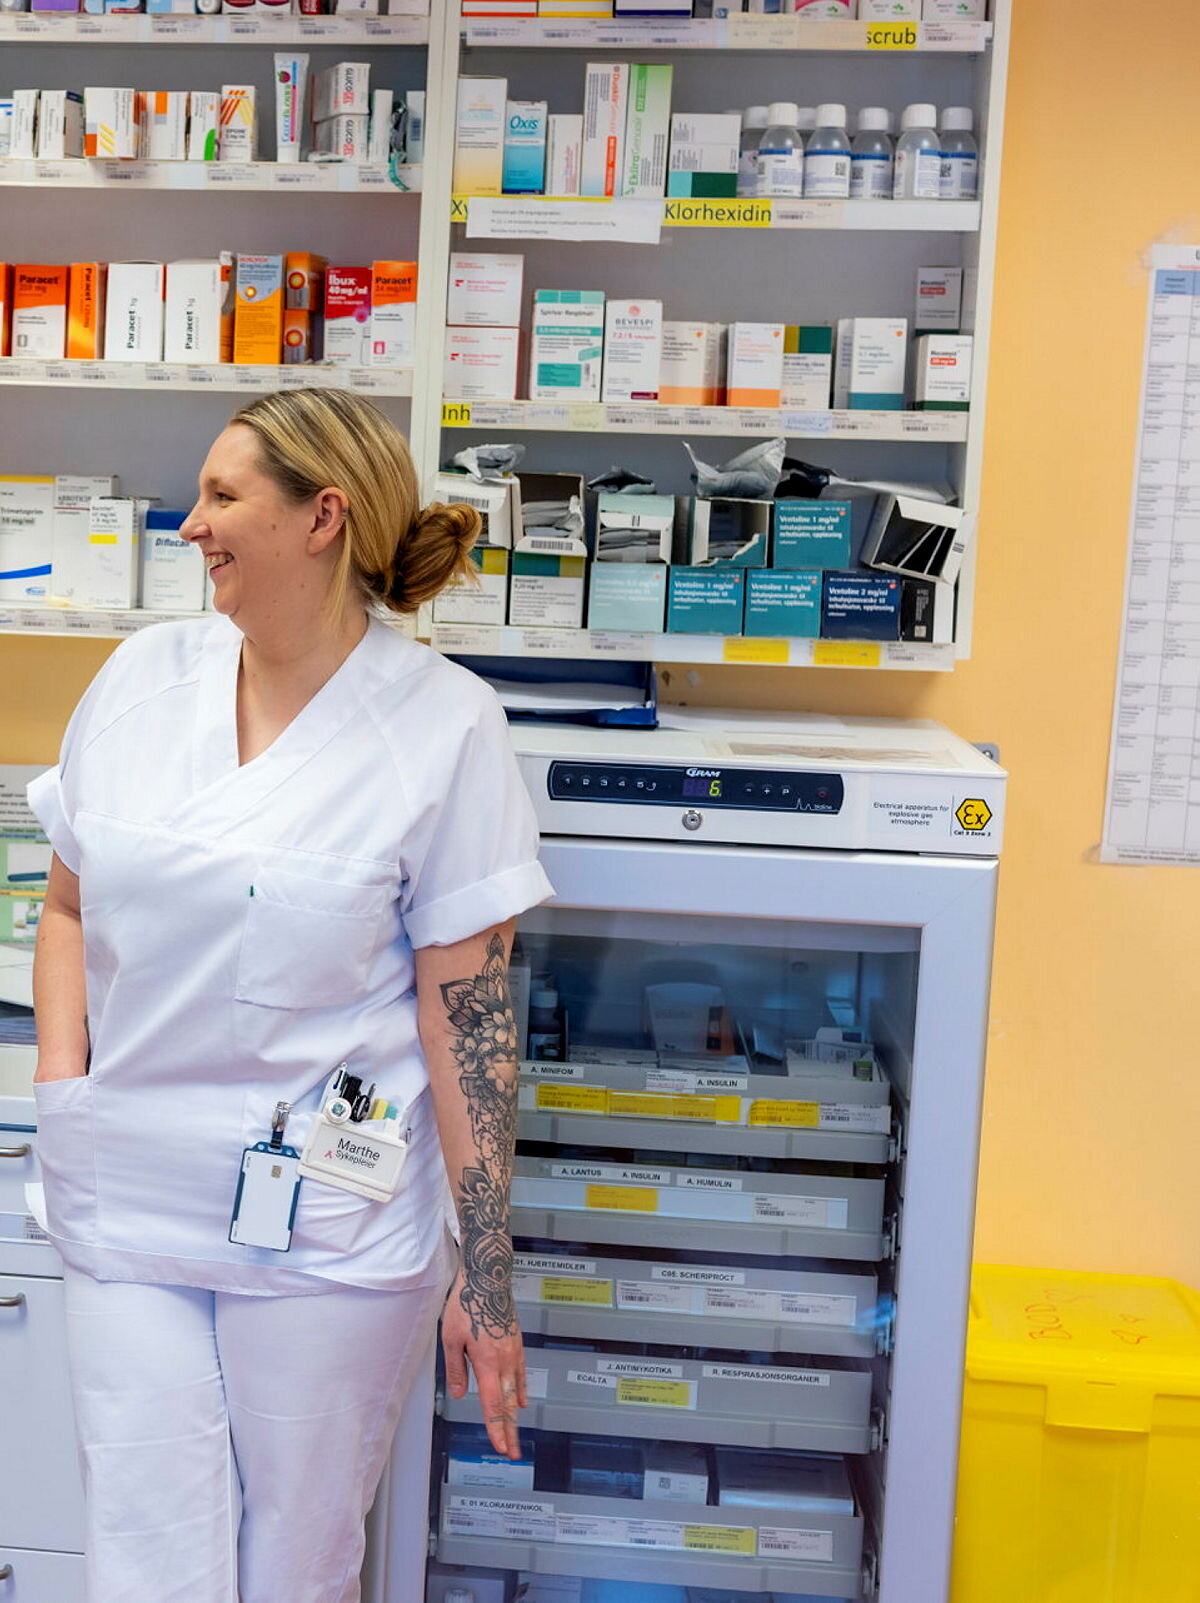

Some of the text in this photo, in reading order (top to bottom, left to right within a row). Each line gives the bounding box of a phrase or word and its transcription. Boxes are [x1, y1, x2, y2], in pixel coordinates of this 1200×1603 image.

[509, 115, 539, 130] Oxis
[663, 203, 772, 223] Klorhexidin
[19, 274, 59, 285] Paracet
[85, 267, 93, 301] Paracet
[328, 274, 356, 286] Ibux
[374, 276, 412, 285] Paracet
[126, 309, 137, 350] Paracet
[185, 309, 195, 350] Paracet
[442, 404, 471, 421] Inh
[541, 1067, 574, 1076] MINIFOM
[706, 1079, 738, 1088] INSULIN
[337, 1138, 381, 1162] Marthe
[570, 1168, 602, 1177] LANTUS
[630, 1172, 661, 1181] INSULIN
[696, 1179, 733, 1189] HUMULIN
[527, 1259, 586, 1271] HJERTEMIDLER
[679, 1270, 735, 1282] SCHERIPROCT
[615, 1364, 672, 1375] ANTIMYKOTIKA
[577, 1374, 608, 1385] ECALTA
[721, 1369, 820, 1383] RESPIRASJONSORGANER
[479, 1501, 543, 1512] KLORAMFENIKOL
